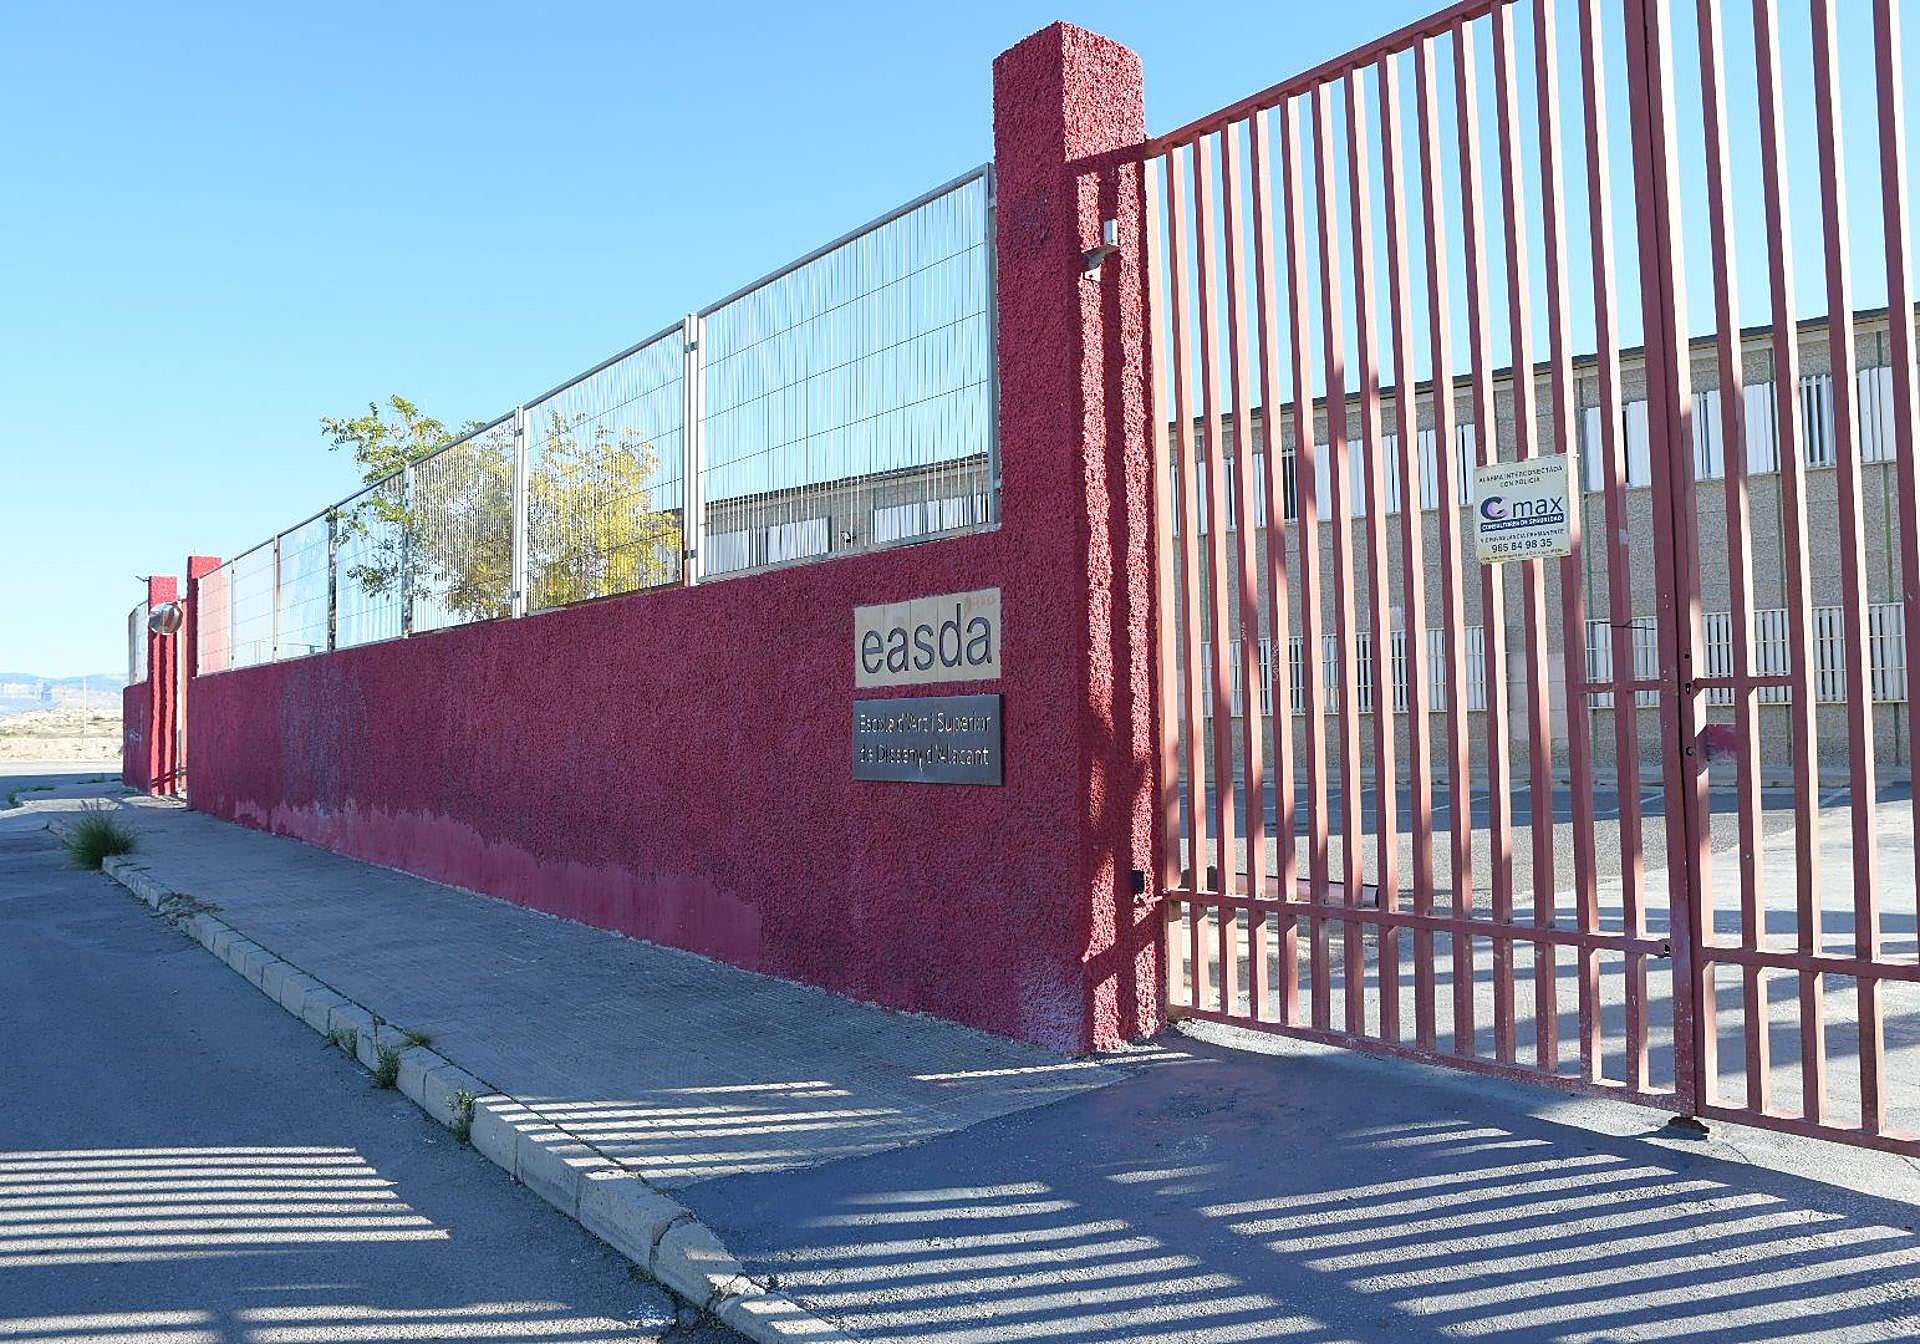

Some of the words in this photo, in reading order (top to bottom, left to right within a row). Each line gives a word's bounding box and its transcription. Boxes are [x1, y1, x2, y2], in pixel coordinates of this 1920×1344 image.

[1480, 474, 1503, 483] ALARMA
[1505, 465, 1563, 479] INTERCONECTADA
[1500, 480, 1514, 488] CON
[1513, 496, 1562, 518] max
[1528, 516, 1563, 525] SEGURIDAD
[1511, 540, 1523, 551] 84
[1525, 539, 1538, 549] 98
[1540, 538, 1553, 547] 35
[861, 602, 992, 674] easda
[859, 712, 894, 733] Escola
[936, 711, 992, 735] Superior
[859, 744, 873, 763] de
[876, 744, 924, 772] Disseny
[926, 744, 990, 766] d'Alacant
